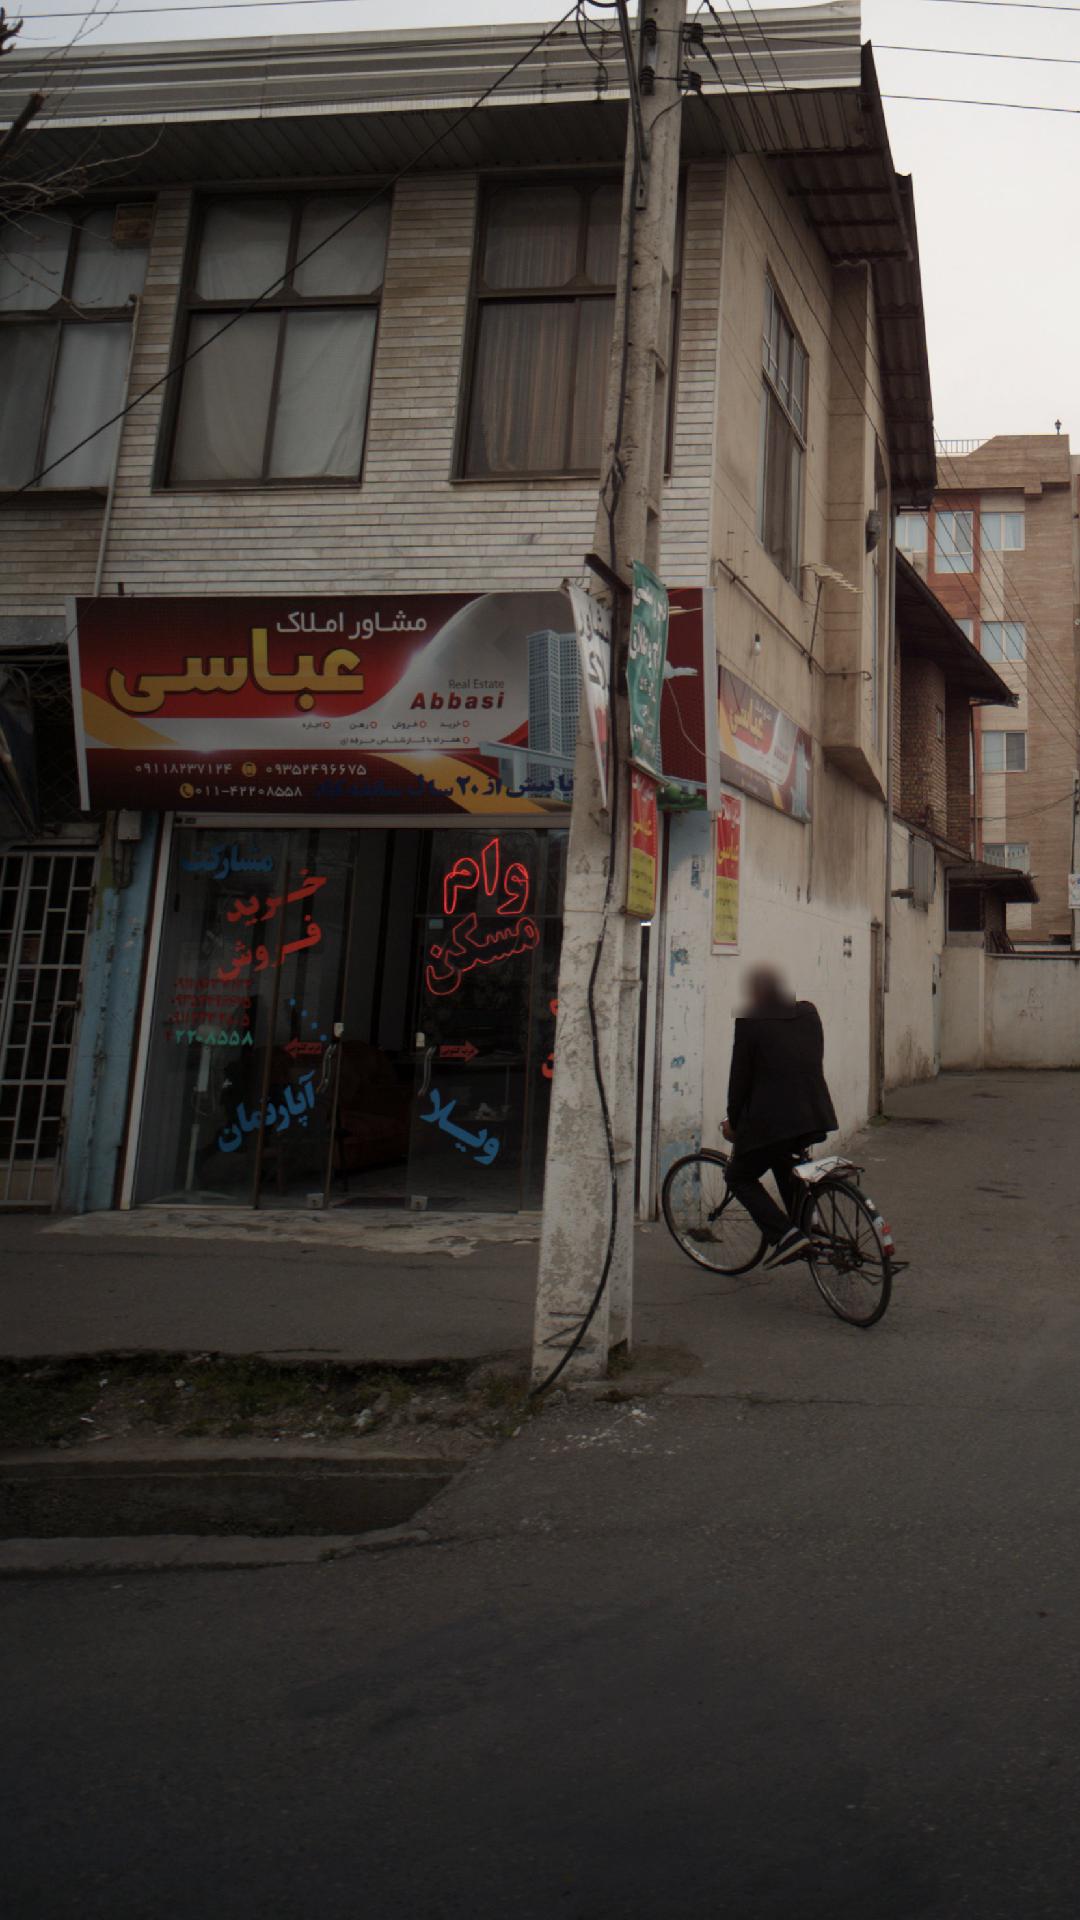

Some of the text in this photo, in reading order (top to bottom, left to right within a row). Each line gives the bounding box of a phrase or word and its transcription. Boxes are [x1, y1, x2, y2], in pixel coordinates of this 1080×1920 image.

[276, 611, 427, 639] مشاور املاک
[106, 628, 365, 713] عباسی
[448, 678, 505, 689] Real Estate
[410, 691, 505, 710] Abbasi
[391, 720, 418, 731] فروش
[135, 762, 232, 774] ۰۹۱۱۸۲۳۷۱۲۴
[265, 763, 367, 776] ۰۹۳۵۲۴۹۶۶۷۵
[456, 775, 478, 796] ۲۰
[179, 843, 273, 880] مشارکت
[443, 836, 530, 915] وام
[226, 867, 329, 926] خرید
[216, 913, 322, 982] فروش
[426, 911, 541, 996] مسکن
[418, 1086, 500, 1166] ویلا
